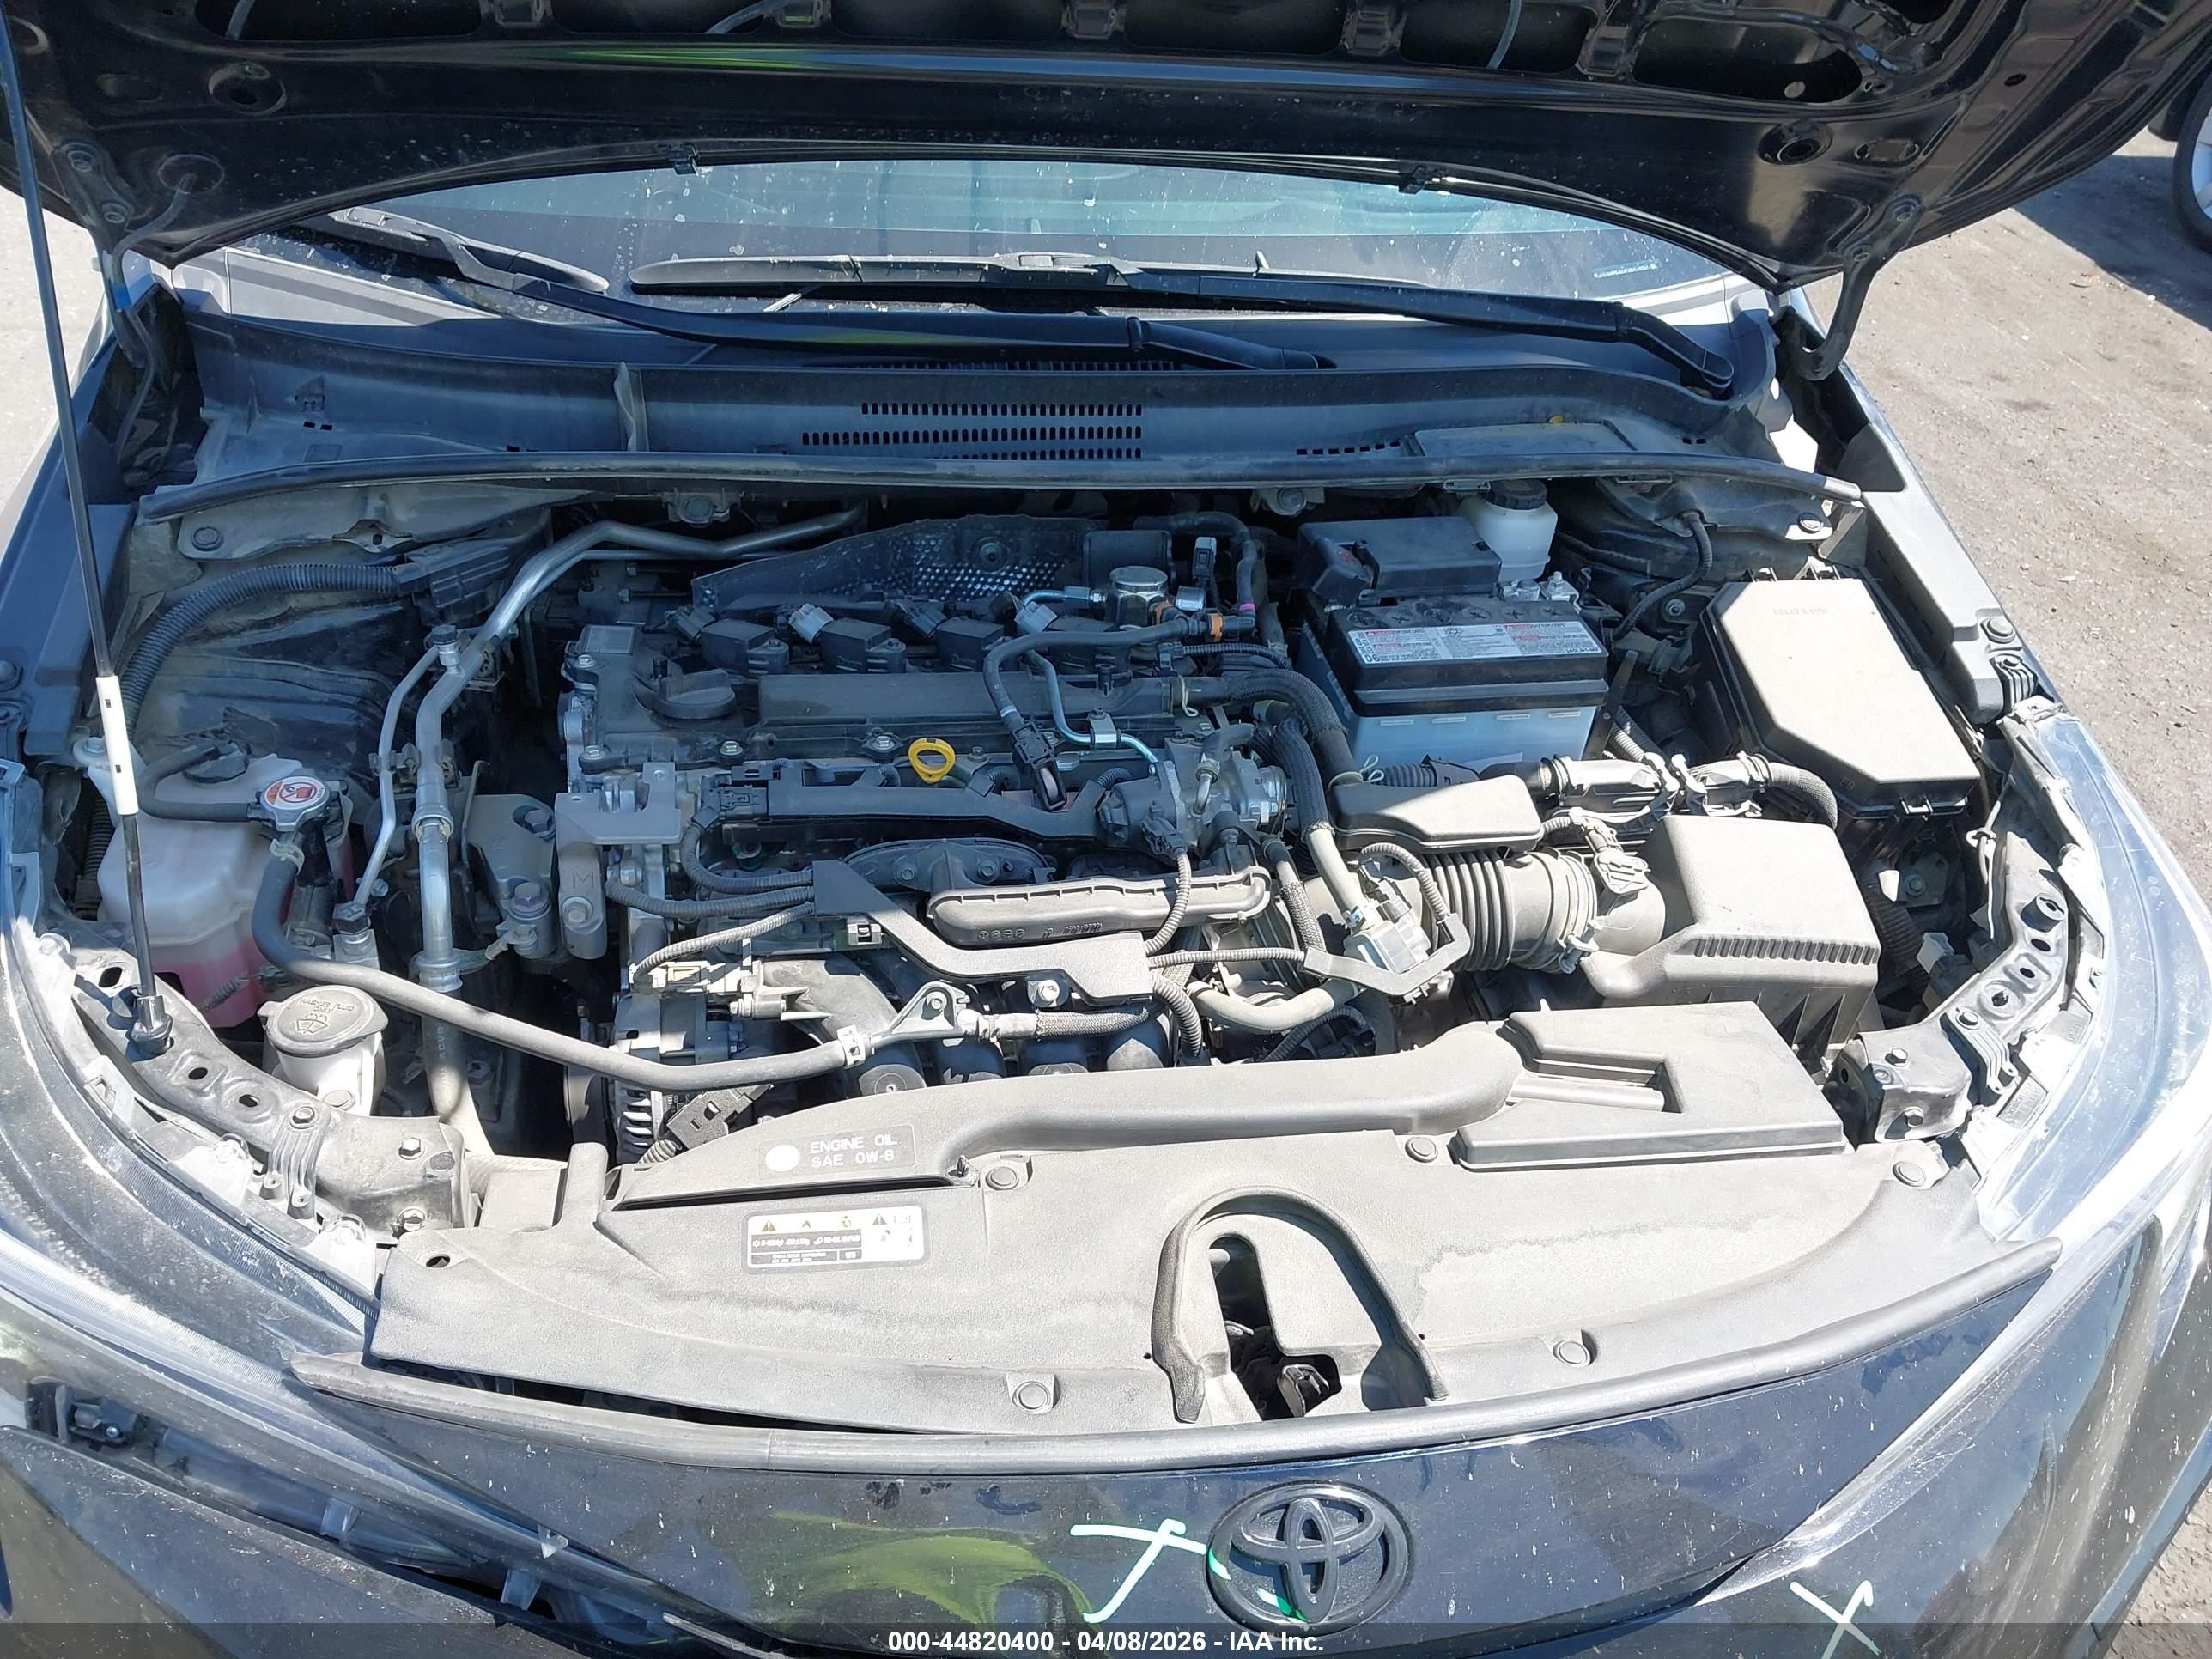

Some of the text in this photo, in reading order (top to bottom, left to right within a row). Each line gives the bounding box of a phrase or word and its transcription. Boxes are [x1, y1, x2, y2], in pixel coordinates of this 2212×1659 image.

[810, 1133, 897, 1153] ENGINE OIL
[811, 1149, 895, 1169] SAE 0W-8
